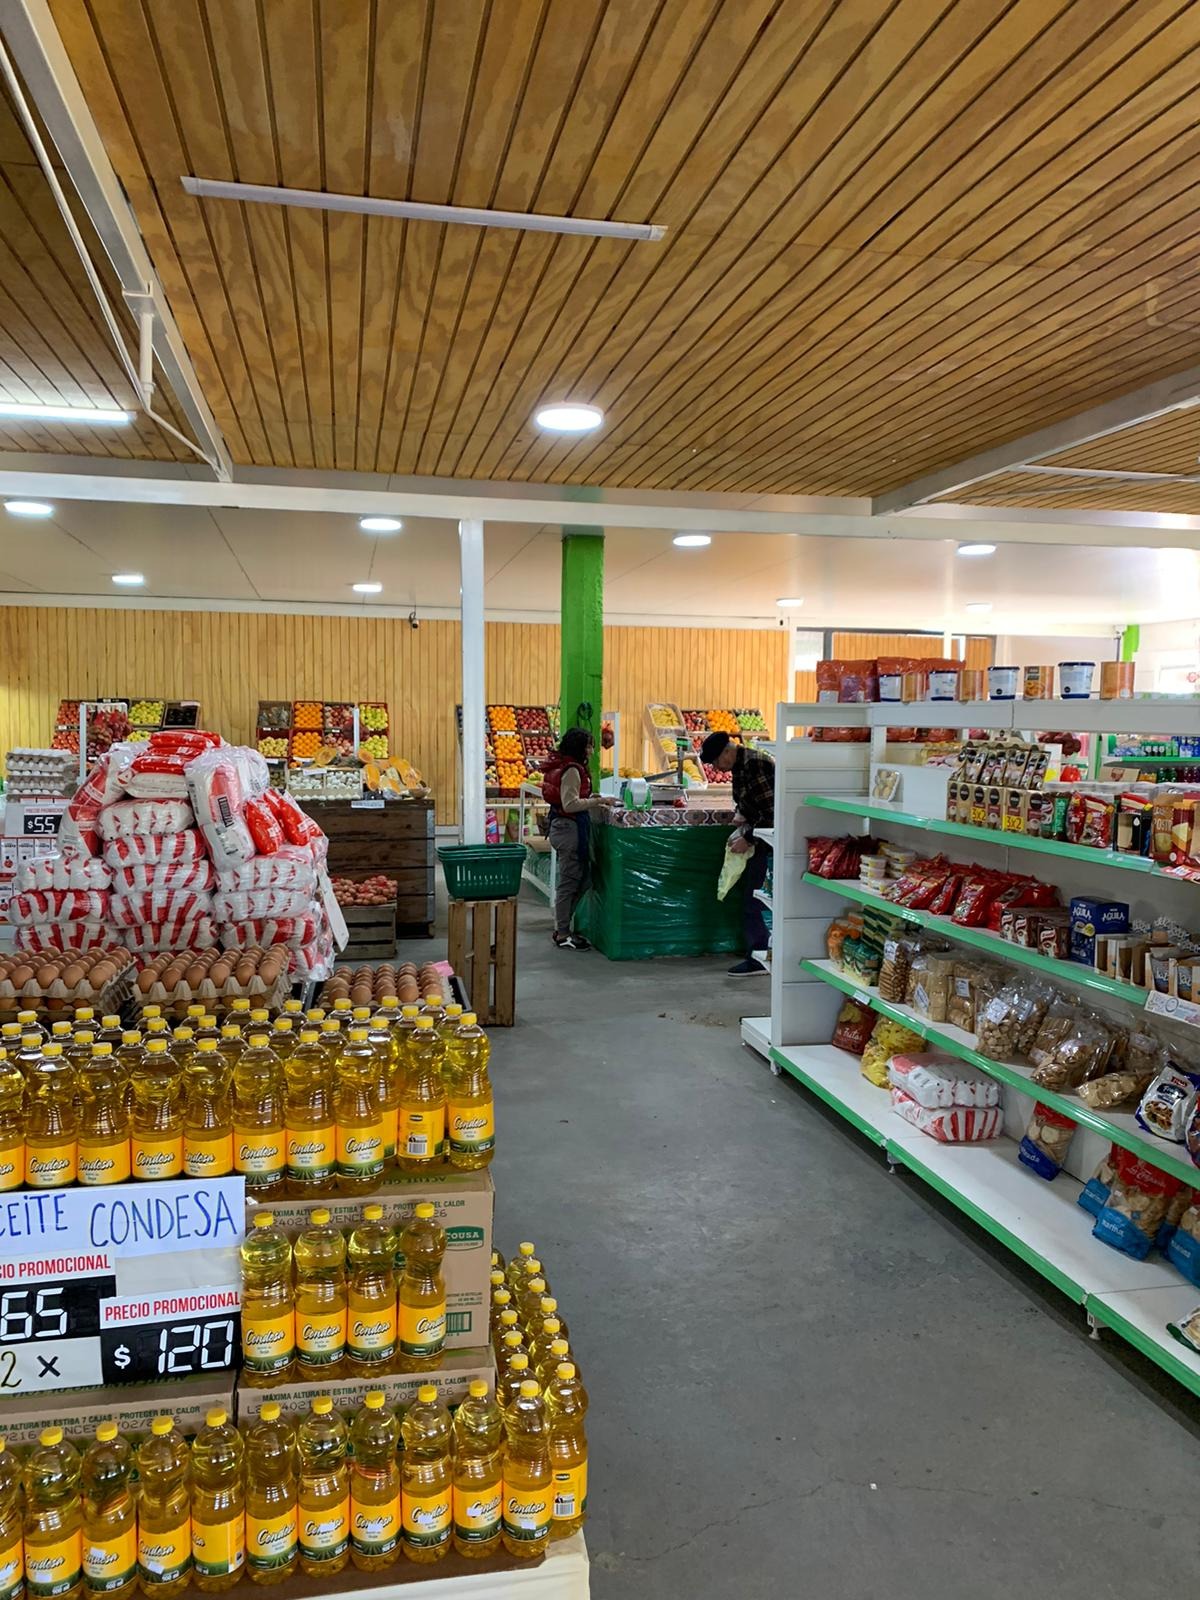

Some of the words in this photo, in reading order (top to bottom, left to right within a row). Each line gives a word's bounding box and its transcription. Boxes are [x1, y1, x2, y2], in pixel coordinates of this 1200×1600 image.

[240, 1143, 279, 1161] Condesa
[288, 1139, 326, 1156] Condesa
[30, 1156, 71, 1174] Condesa
[135, 1150, 176, 1167] Condesa
[90, 1190, 238, 1248] CONDESA
[18, 1253, 111, 1278] PROMOCIONAL
[105, 1302, 150, 1321] PRECIO
[153, 1291, 240, 1316] PROMOCIONAL
[245, 1328, 285, 1346] Condesa
[302, 1323, 341, 1341] Condesa
[114, 1344, 131, 1370] $
[158, 1320, 234, 1374] 120
[0, 1351, 22, 1388] 2
[292, 1388, 320, 1399] ALTURA
[332, 1386, 357, 1396] ESTIBA
[10, 1422, 40, 1431] ALTURA
[53, 1418, 80, 1427] ESTIBA
[508, 1497, 546, 1517] Condesa
